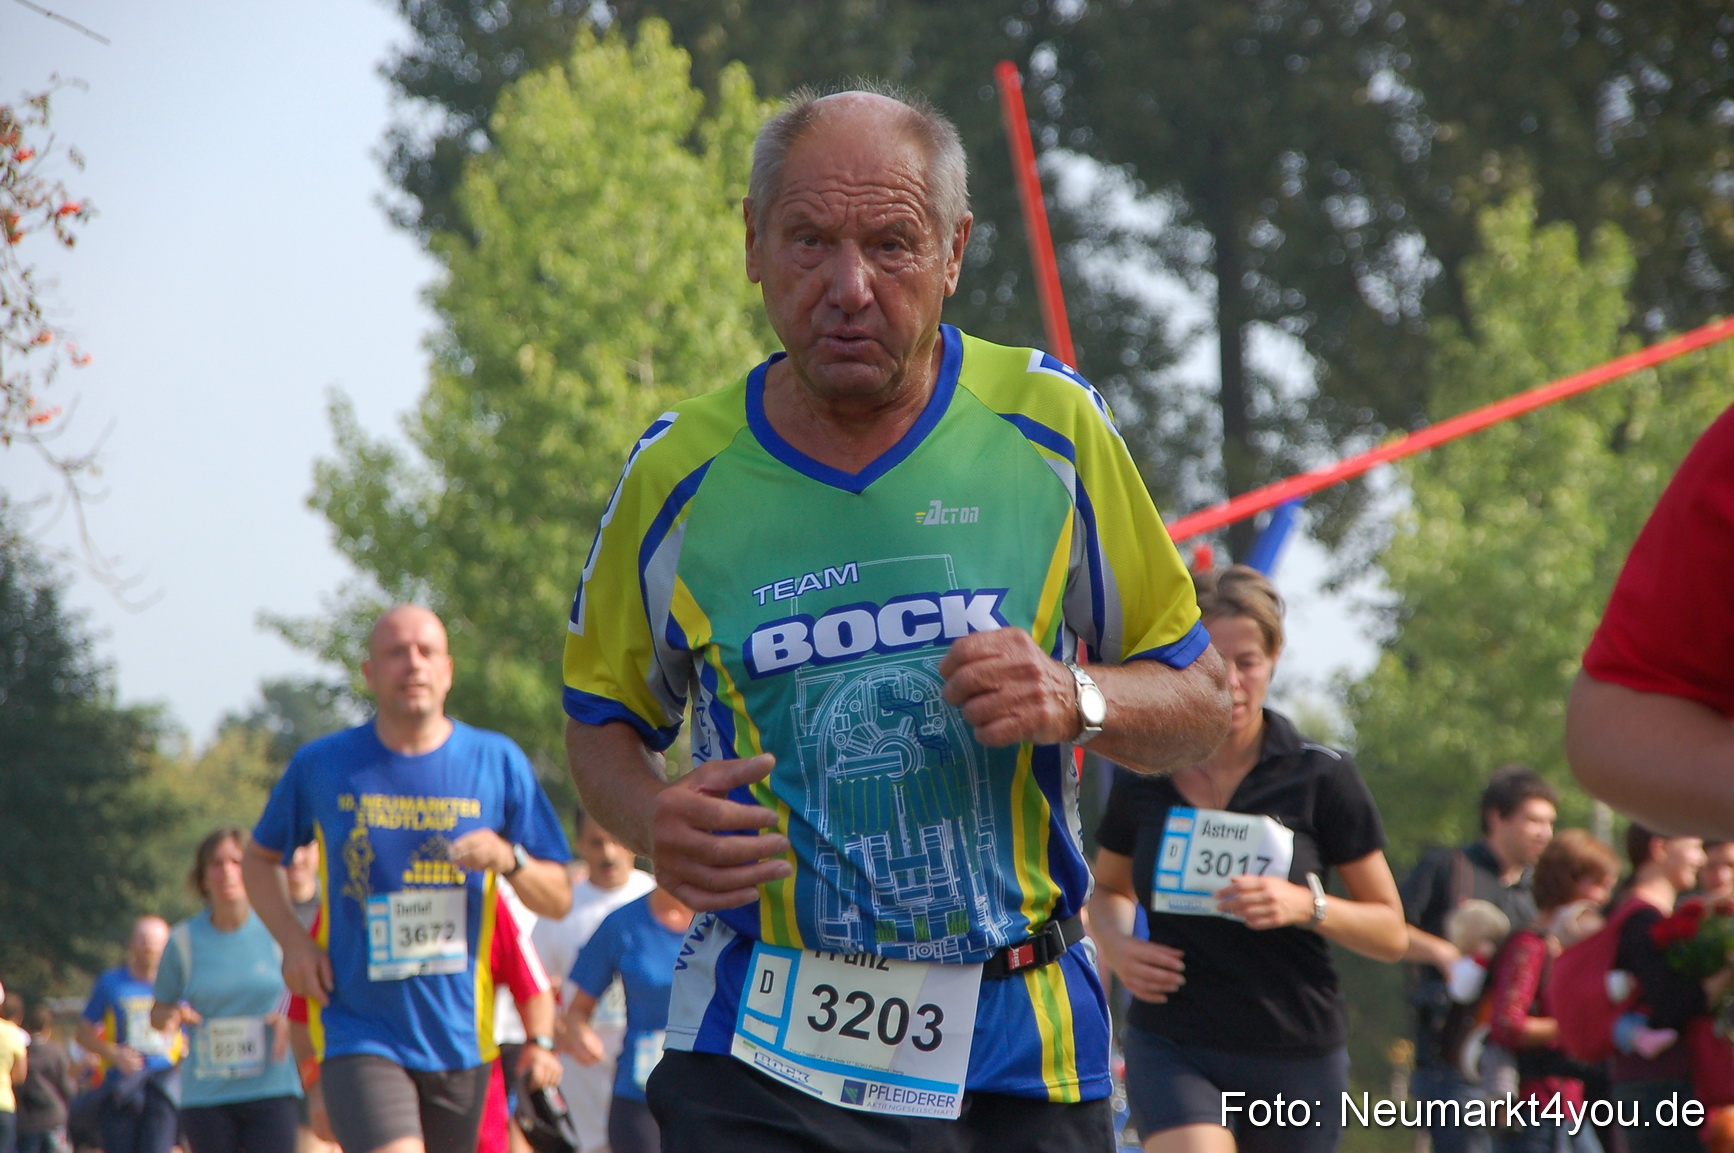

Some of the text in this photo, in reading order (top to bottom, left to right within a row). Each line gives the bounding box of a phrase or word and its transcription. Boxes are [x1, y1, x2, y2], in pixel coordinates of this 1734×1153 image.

[752, 561, 860, 606] TEAM
[745, 588, 1009, 678] BOCK
[360, 793, 482, 819] NEUMARKTER
[357, 810, 458, 831] STADTLAUF
[1202, 819, 1249, 841] Astrid
[1196, 849, 1274, 877] 3017
[400, 921, 457, 949] 3672
[759, 969, 775, 994] D
[807, 983, 944, 1052] 3203
[754, 1052, 811, 1083] BOCK
[866, 1101, 954, 1116] AKTIENGESELLSCHAFT
[868, 1084, 956, 1108] PFLEIDERER
